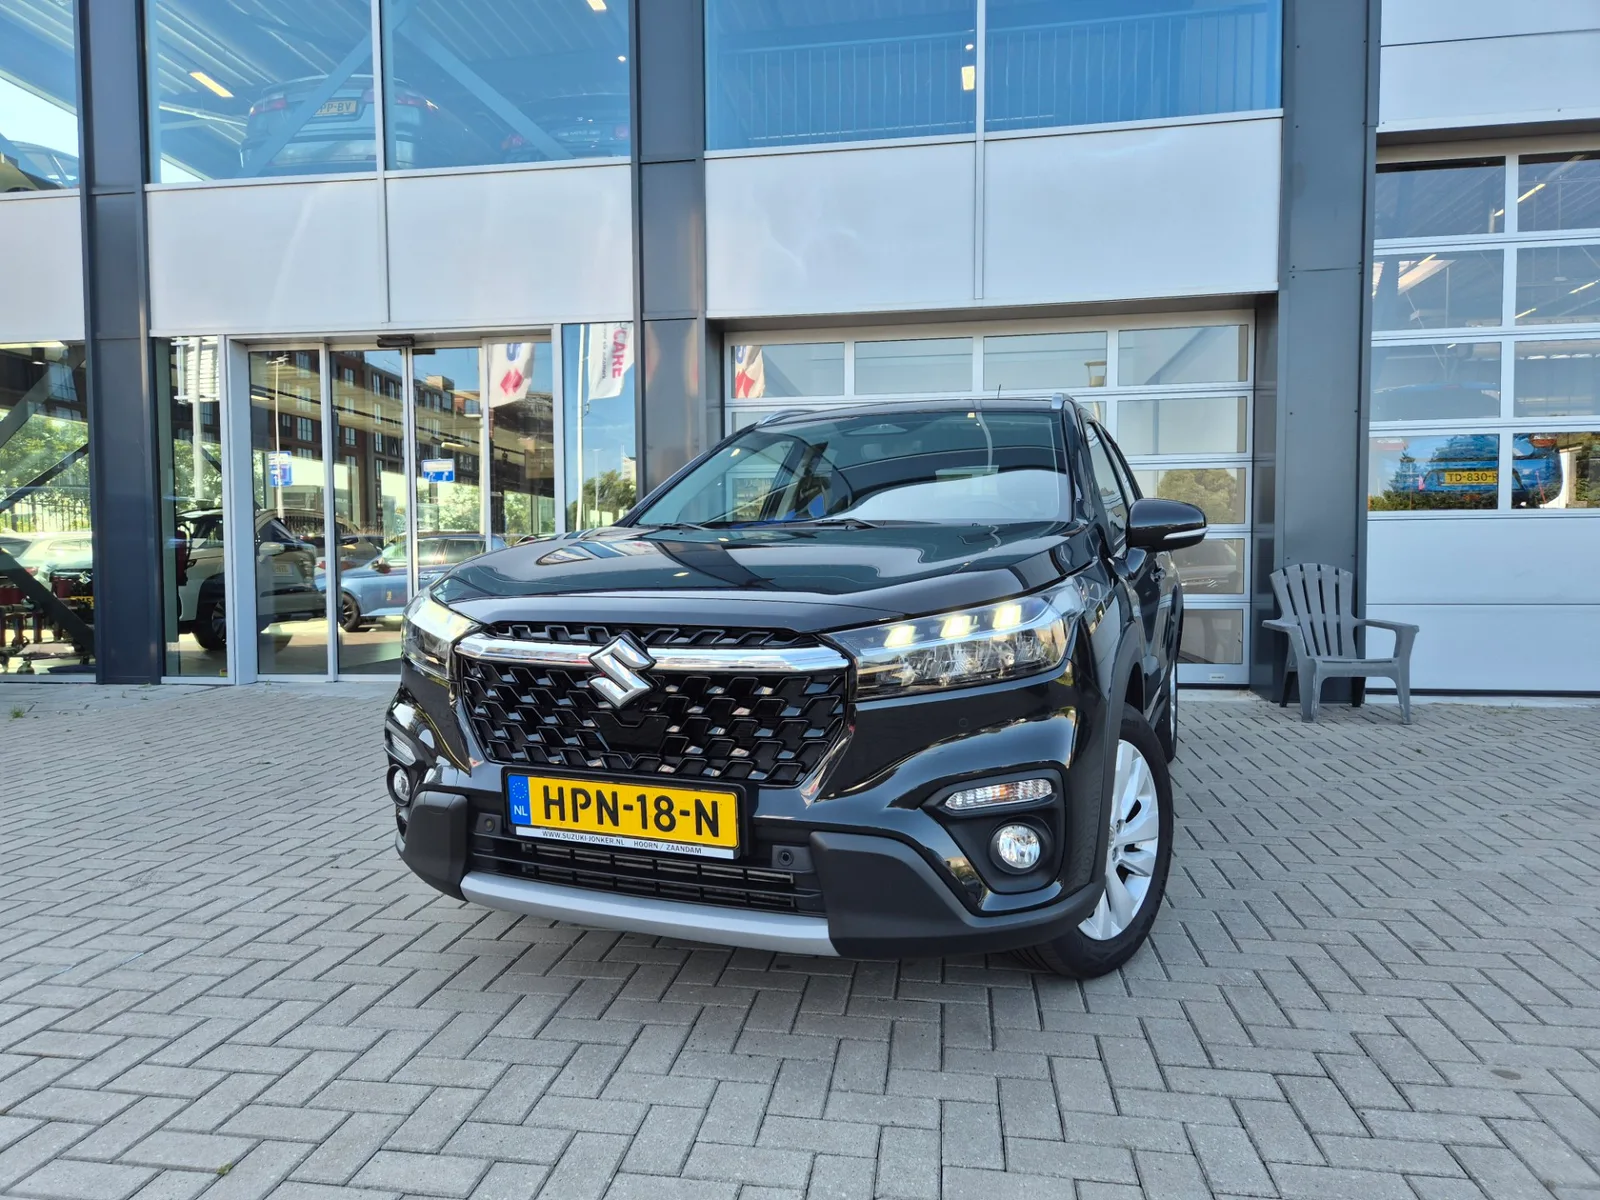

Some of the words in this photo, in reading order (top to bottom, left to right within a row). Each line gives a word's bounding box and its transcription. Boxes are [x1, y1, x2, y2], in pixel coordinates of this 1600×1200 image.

[513, 804, 528, 817] NL
[543, 785, 719, 838] HPN-18-N
[633, 840, 659, 850] HOORN
[665, 844, 702, 854] ZAANDAM
